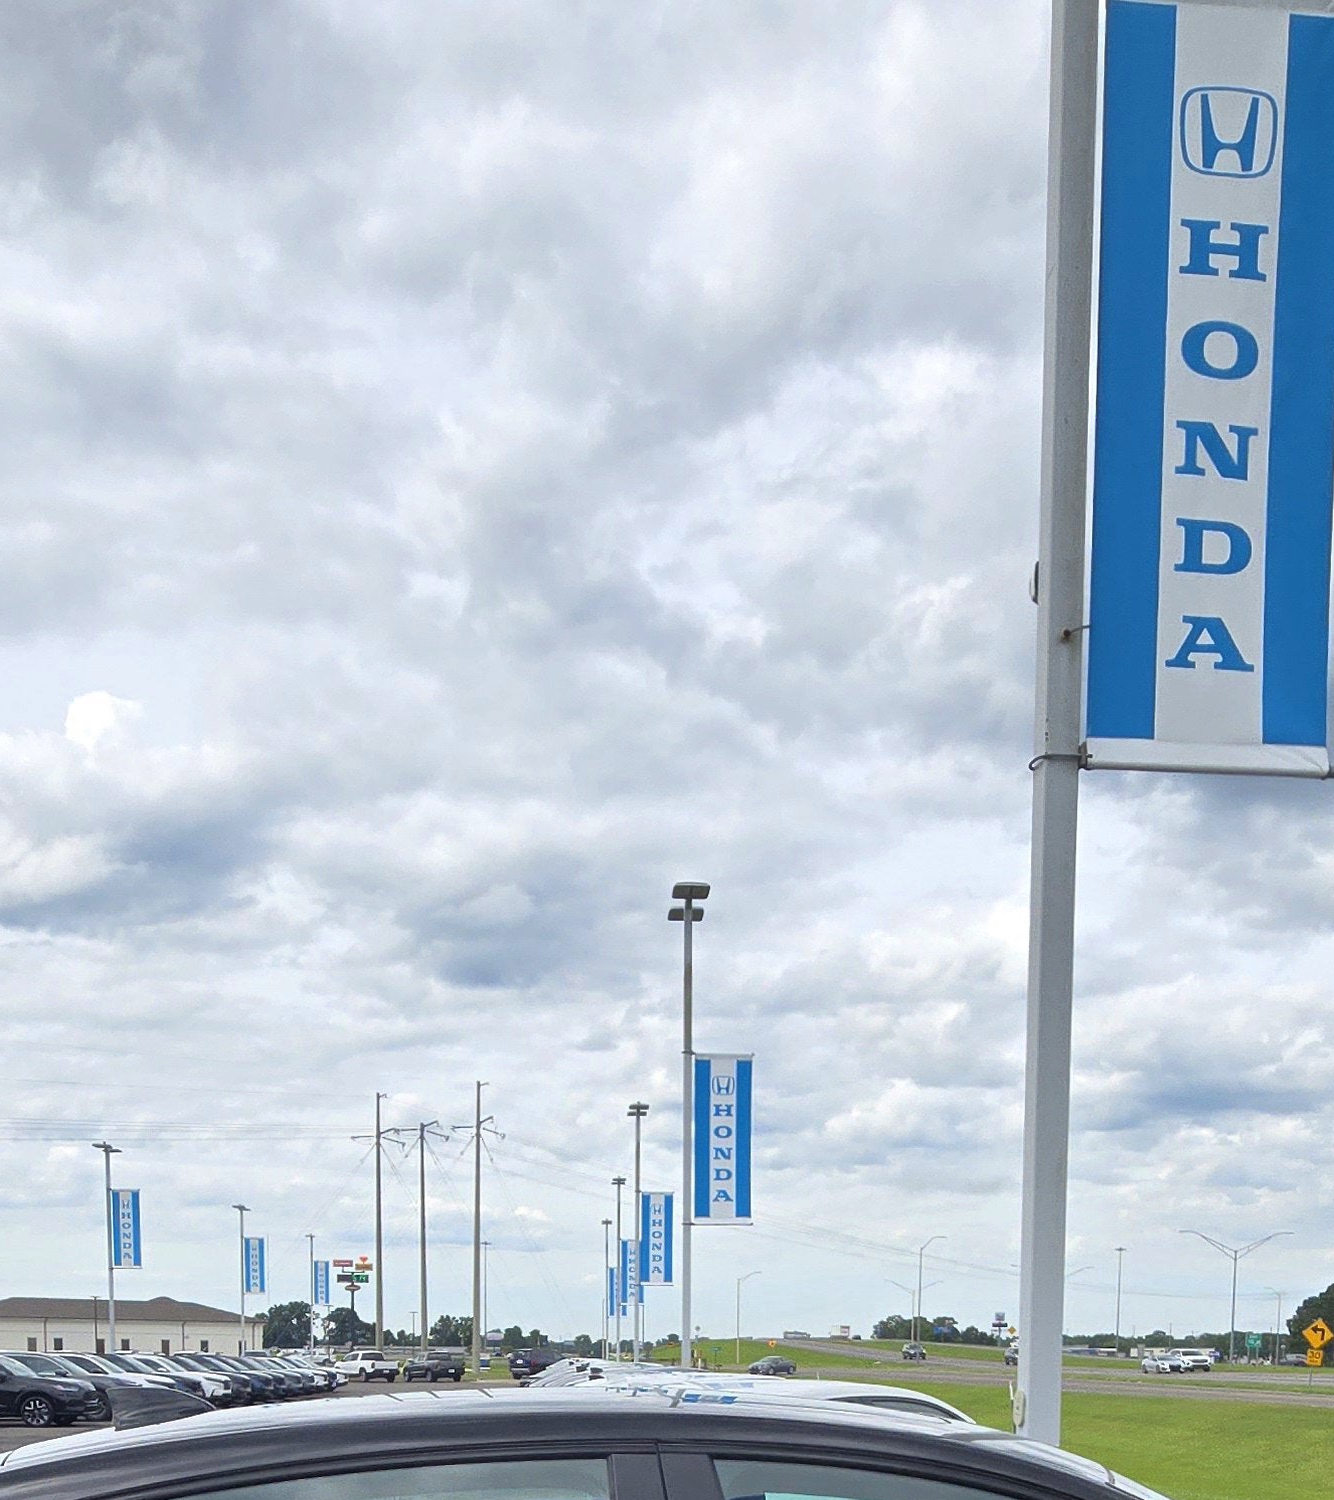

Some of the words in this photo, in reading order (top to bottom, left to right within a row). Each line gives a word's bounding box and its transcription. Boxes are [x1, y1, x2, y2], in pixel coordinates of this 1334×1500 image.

[1166, 218, 1268, 673] HONDA
[712, 1104, 733, 1202] HONDA
[121, 1212, 132, 1259] HONDA
[652, 1219, 663, 1274] HONDA
